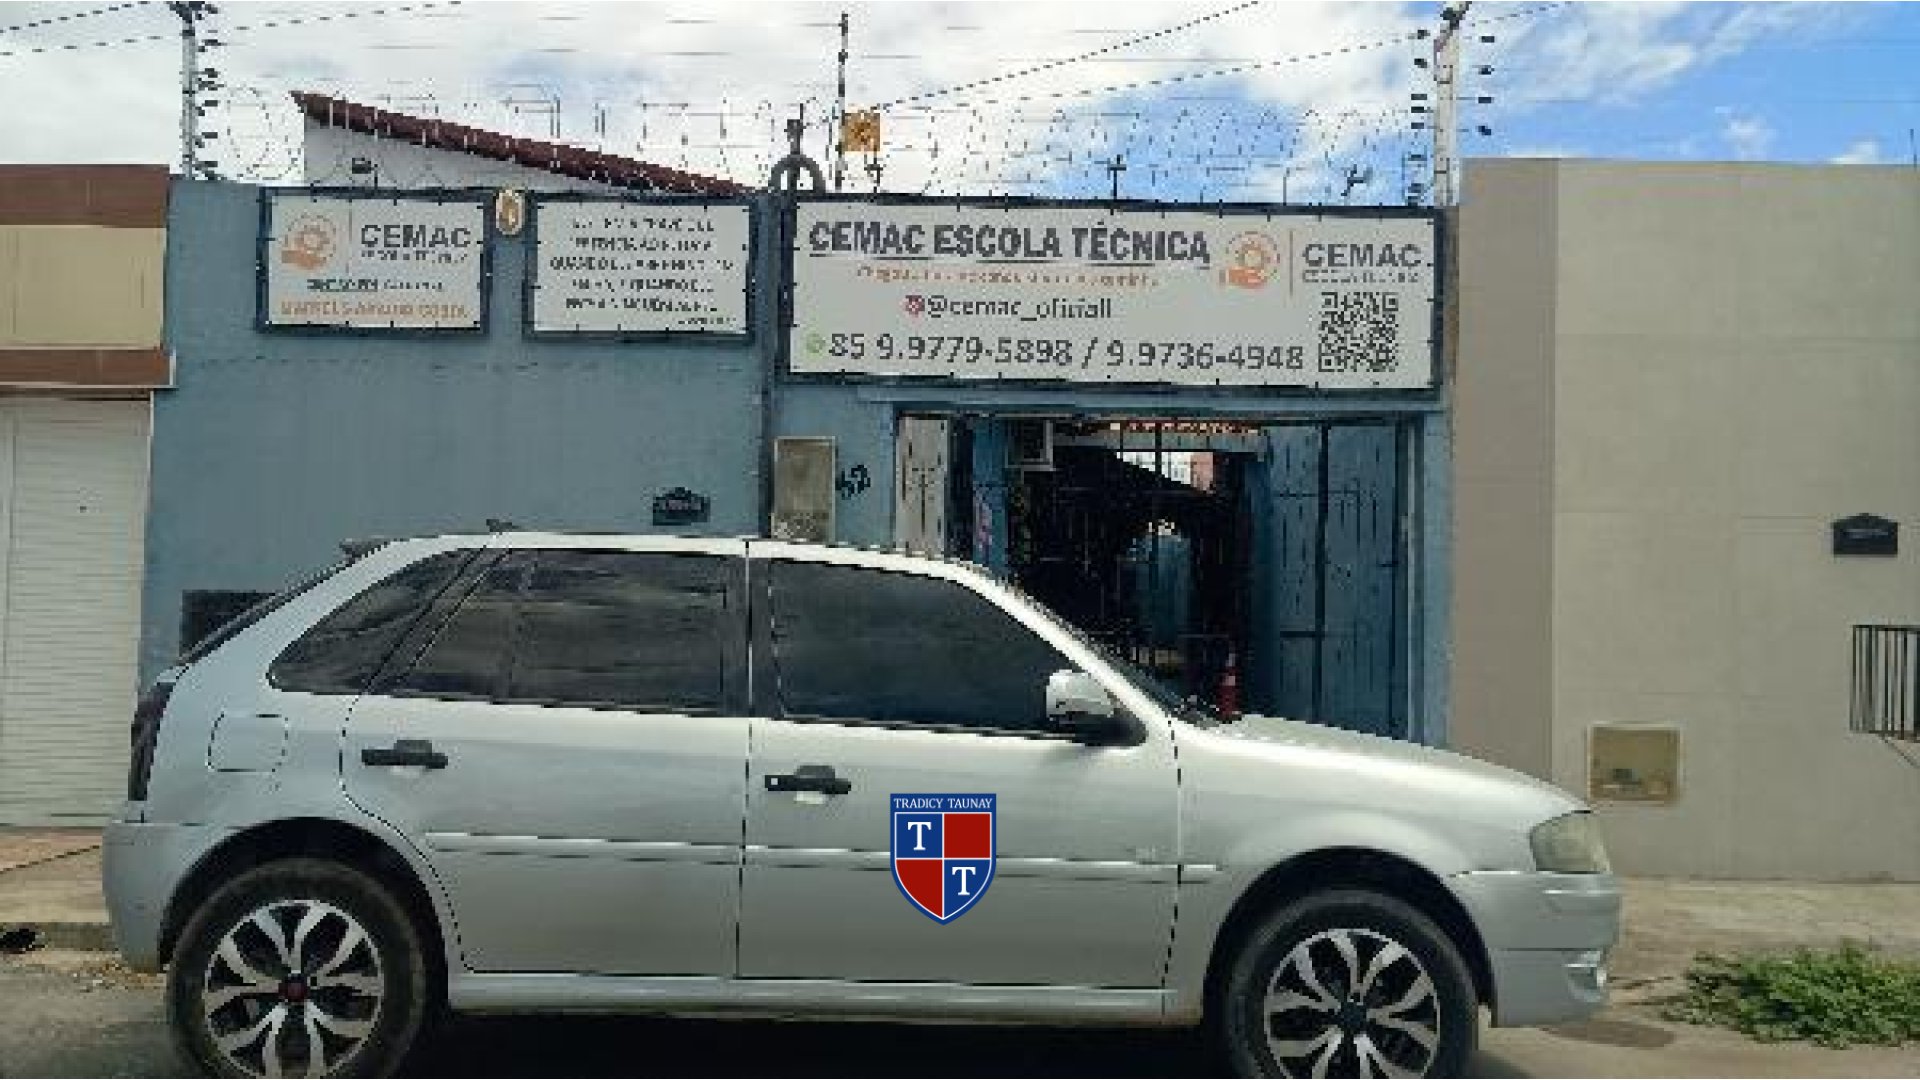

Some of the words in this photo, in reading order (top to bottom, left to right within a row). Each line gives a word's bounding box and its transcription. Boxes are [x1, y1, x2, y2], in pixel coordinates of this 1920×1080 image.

[361, 224, 471, 248] CEMAC
[809, 221, 926, 254] CEMAC
[934, 224, 1063, 258] ESCOLA
[1071, 221, 1211, 264] TÉCNICA
[1303, 243, 1422, 268] CEMAC
[829, 333, 865, 360] 85
[875, 333, 1074, 366] 9.9779-5898
[1081, 336, 1099, 369] /
[1106, 339, 1304, 370] 9.9736-4948
